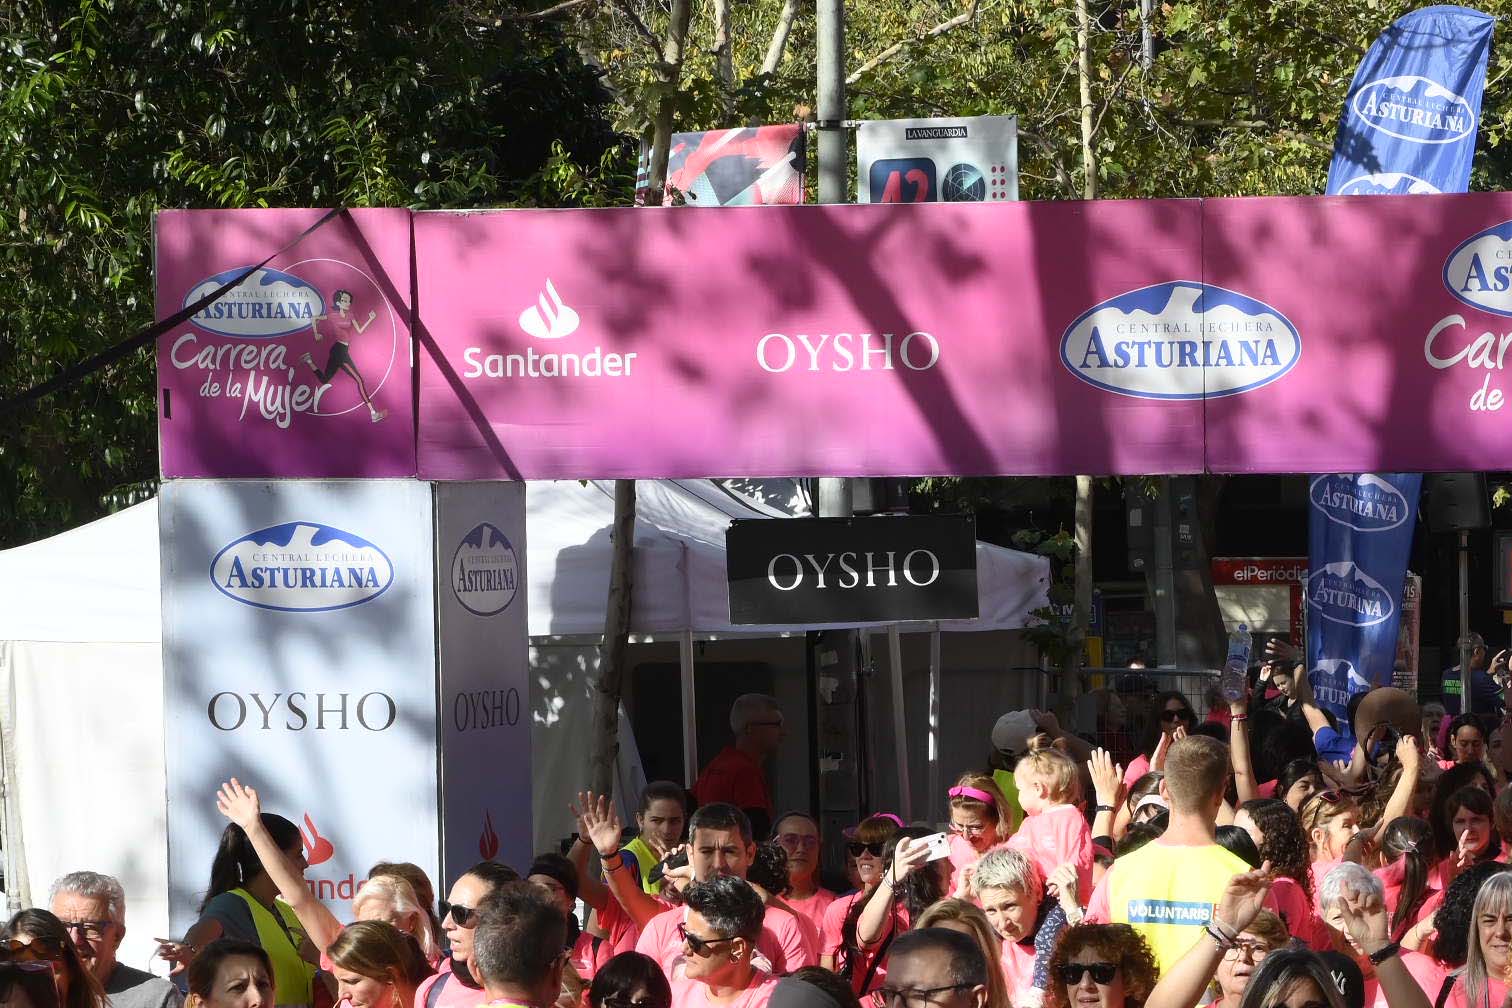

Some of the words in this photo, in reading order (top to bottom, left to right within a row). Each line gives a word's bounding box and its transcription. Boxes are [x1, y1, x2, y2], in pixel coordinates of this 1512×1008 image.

[1362, 91, 1464, 133] ASTURIANA
[194, 293, 313, 320] ASTURIANA
[1116, 323, 1191, 334] CENTRAL
[1199, 320, 1274, 333] LECHERA
[171, 332, 289, 370] Carrera
[464, 346, 637, 380] Santander
[756, 331, 940, 373] OYSHO
[1080, 325, 1281, 369] ASTURIANA
[200, 372, 221, 397] de
[226, 372, 241, 397] la
[239, 368, 332, 429] Mujer
[1469, 372, 1504, 412] de
[225, 555, 380, 590] ASTURIANA
[252, 552, 307, 562] CENTRAL
[457, 558, 515, 593] ASTURIANA
[767, 549, 940, 591] OYSHO
[207, 690, 398, 732] OYSHO
[454, 687, 520, 732] OYSHO
[1129, 903, 1210, 921] VOLUNTARIS
